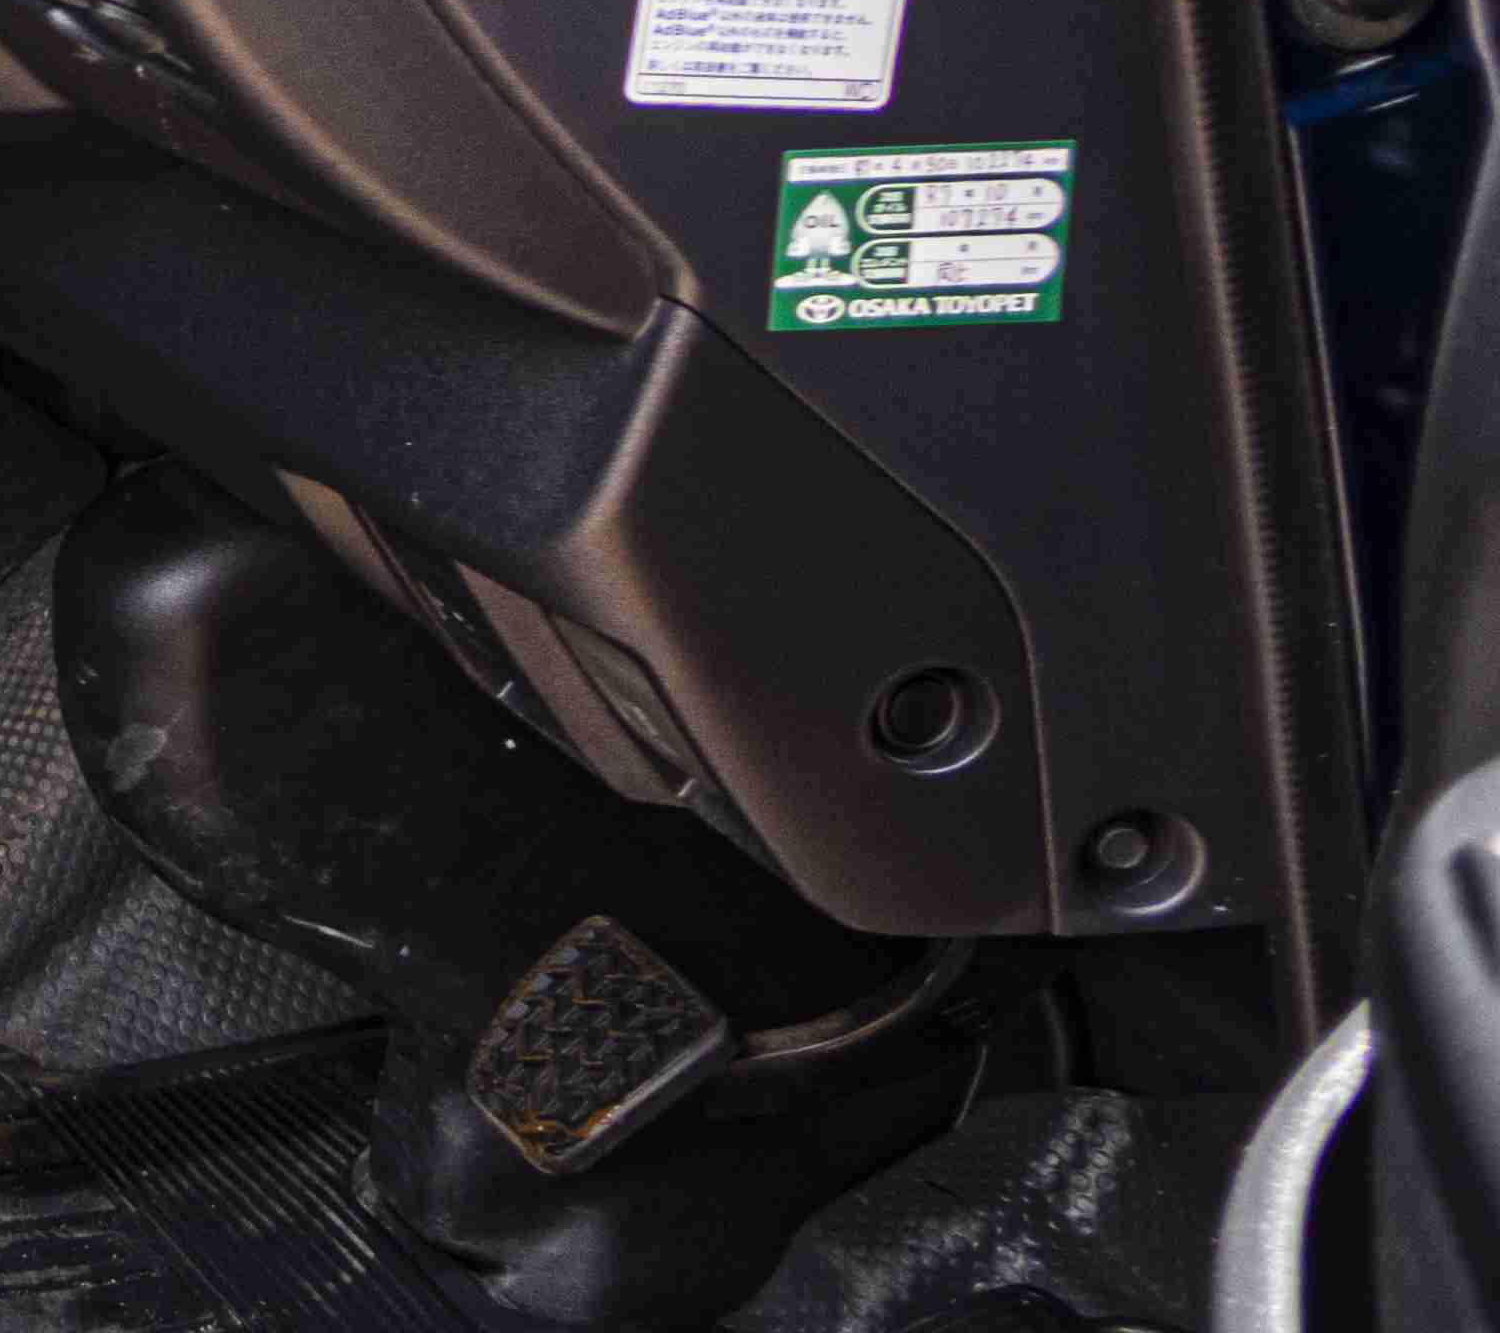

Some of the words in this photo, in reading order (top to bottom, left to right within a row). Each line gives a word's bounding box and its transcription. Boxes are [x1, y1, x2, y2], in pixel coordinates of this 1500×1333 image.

[803, 214, 840, 230] OIL
[847, 297, 932, 318] OSAKA
[934, 292, 1040, 315] TOYOPET
